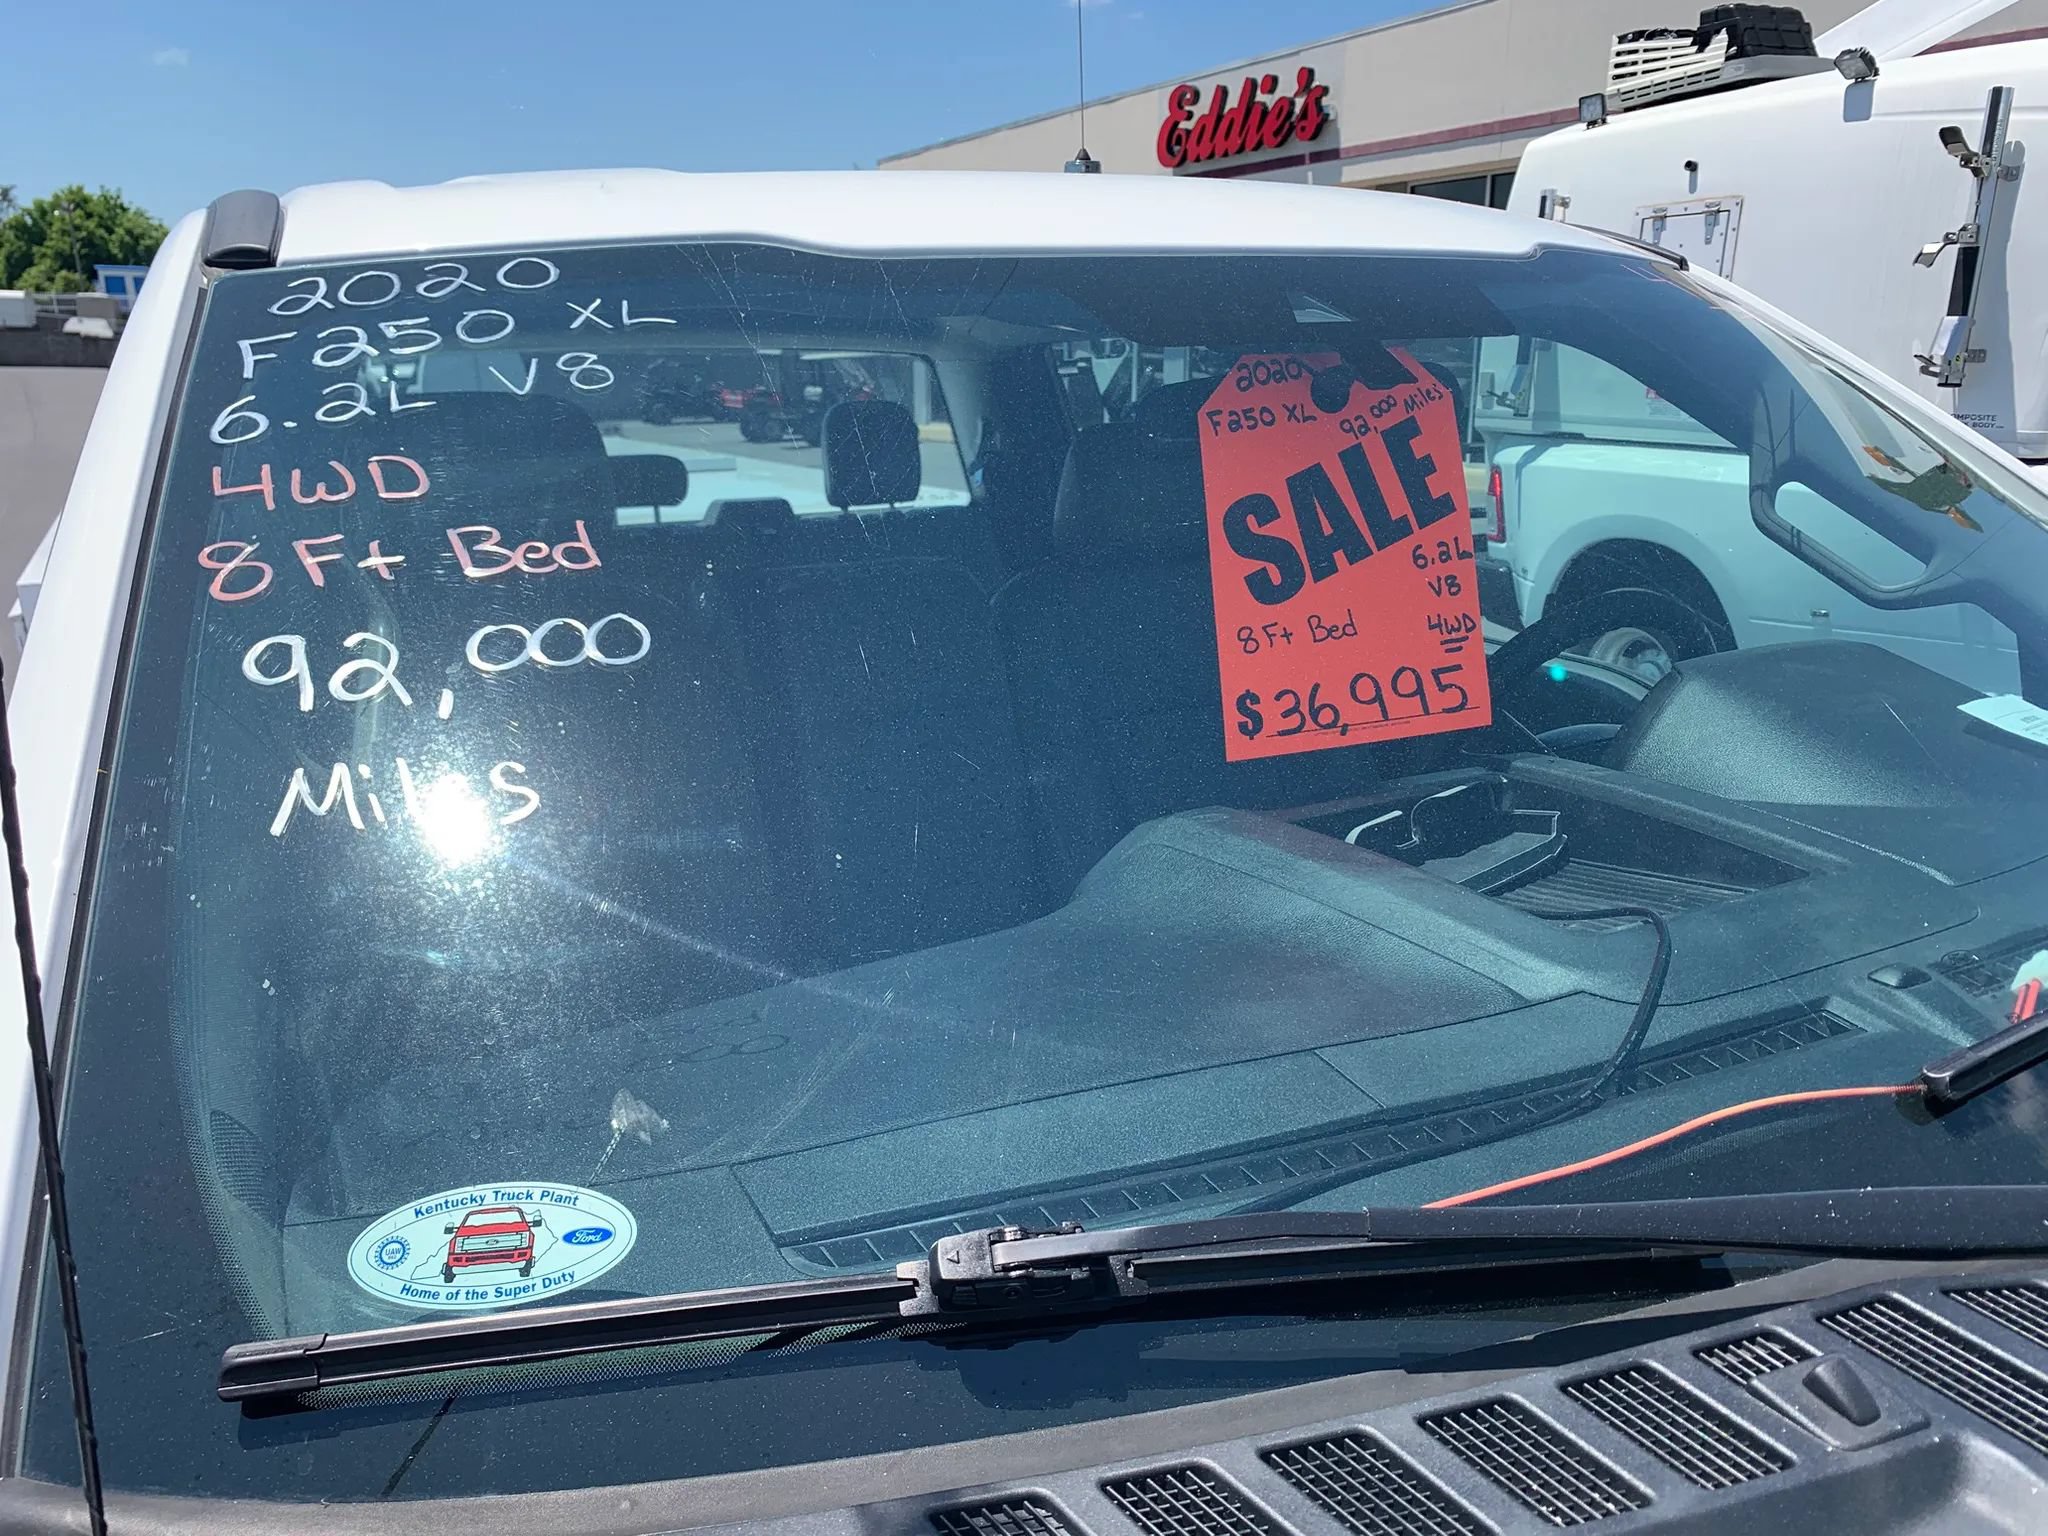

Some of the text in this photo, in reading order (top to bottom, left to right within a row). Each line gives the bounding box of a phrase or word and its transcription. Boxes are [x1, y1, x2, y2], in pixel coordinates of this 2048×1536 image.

[1157, 66, 1329, 168] Eddie's
[267, 258, 560, 316] 2020
[567, 298, 677, 330] XL
[1236, 358, 1303, 393] 2020
[209, 352, 614, 445] 6.2L V8
[1206, 405, 1276, 437] F250
[1281, 403, 1318, 424] XL
[1403, 384, 1444, 415] Miles
[1951, 413, 1997, 422] OMPOSITE
[212, 454, 430, 511] 4WD
[1223, 415, 1457, 606] SALE
[198, 540, 273, 602] 8
[446, 520, 602, 579] Bed
[1412, 536, 1473, 570] 6.2L
[1307, 608, 1358, 643] Bed
[1427, 613, 1477, 636] 4WD
[242, 613, 651, 720] 92,000
[270, 757, 541, 837] Mils
[414, 1190, 580, 1219] Kentucky Truck Plant
[385, 1248, 402, 1256] UAW
[572, 1229, 602, 1244] Ford
[400, 1270, 576, 1301] Home of the Super Duty
